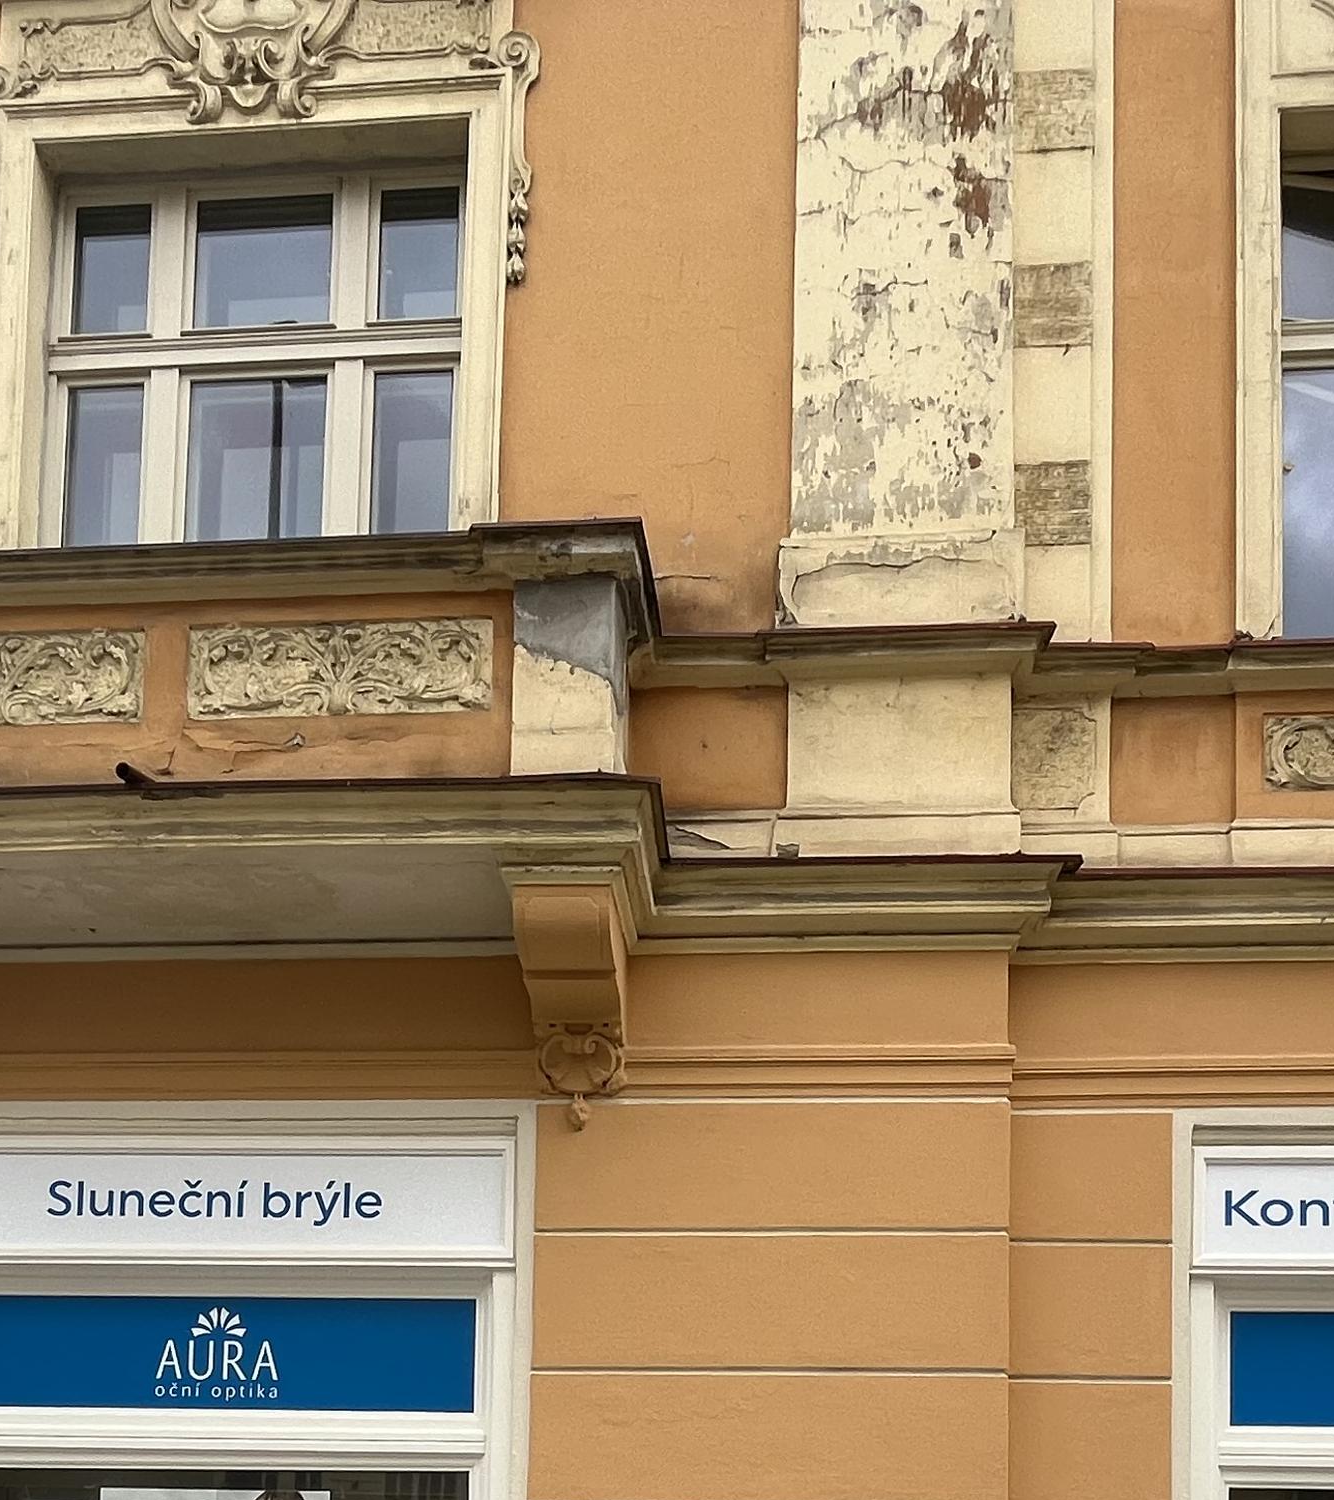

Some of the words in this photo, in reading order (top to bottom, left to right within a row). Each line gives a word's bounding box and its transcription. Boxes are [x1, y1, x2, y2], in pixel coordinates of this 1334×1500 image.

[46, 1179, 247, 1219] Sluneční
[261, 1179, 383, 1227] brýle
[155, 1339, 279, 1382] AURA
[155, 1382, 201, 1398] oční
[211, 1383, 279, 1402] optika
